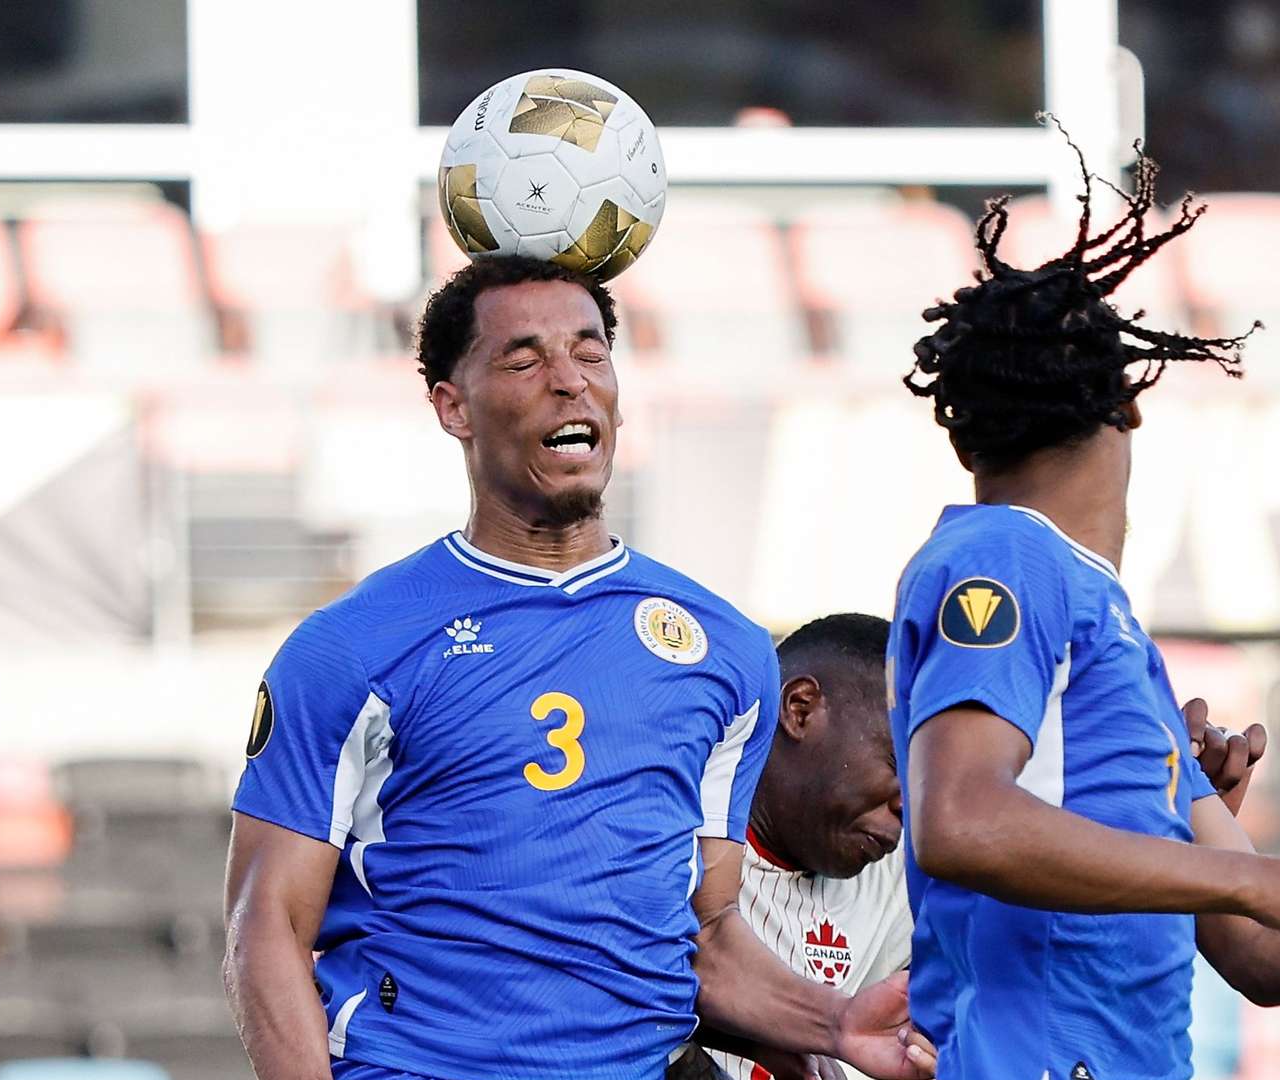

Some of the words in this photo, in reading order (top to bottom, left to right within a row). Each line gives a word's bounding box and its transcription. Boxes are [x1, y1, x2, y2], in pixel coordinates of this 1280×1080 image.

[443, 643, 495, 659] KELME
[523, 691, 586, 791] 3
[805, 946, 852, 961] CANADA
